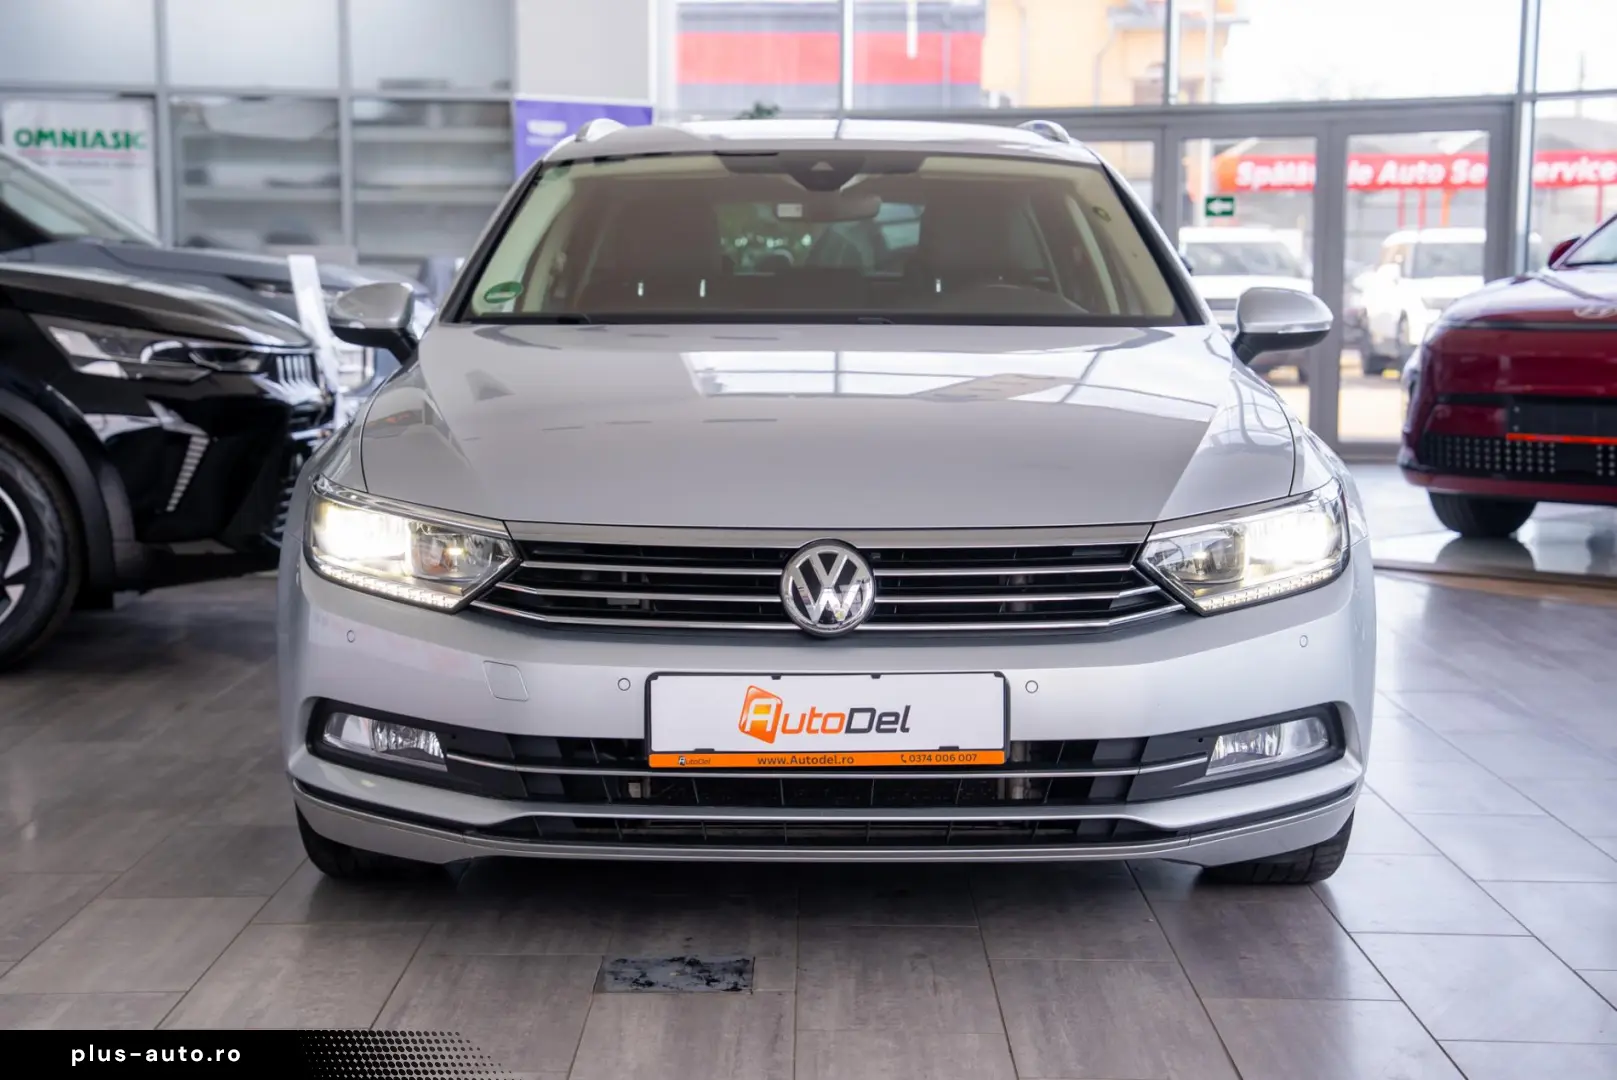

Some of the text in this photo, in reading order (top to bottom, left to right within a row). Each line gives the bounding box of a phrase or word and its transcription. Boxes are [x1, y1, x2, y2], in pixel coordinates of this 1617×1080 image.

[1378, 160, 1445, 183] Auto
[785, 544, 870, 630] VW
[742, 695, 911, 736] AutoDel
[678, 755, 712, 767] AutoDel
[757, 754, 855, 766] www.Autodel.ro
[908, 753, 978, 763] 0374 006 007
